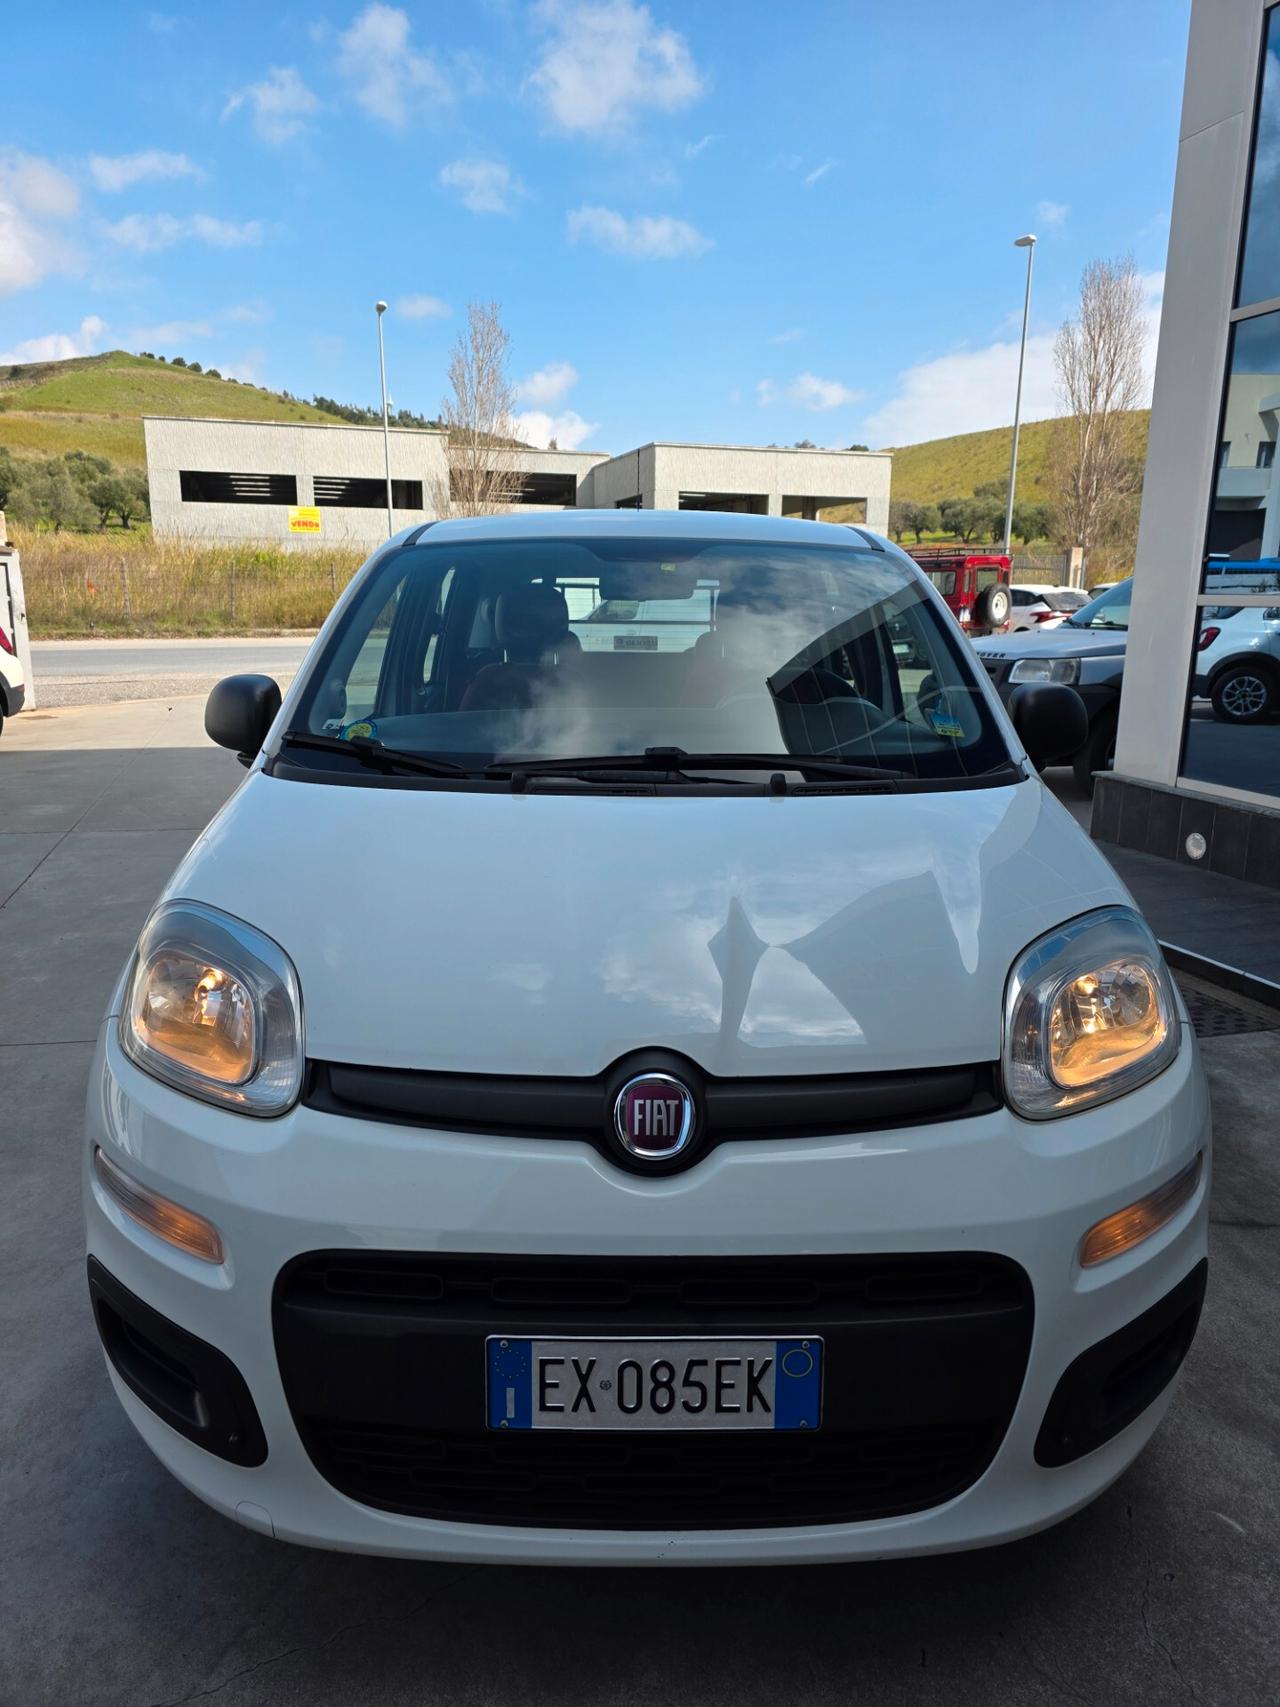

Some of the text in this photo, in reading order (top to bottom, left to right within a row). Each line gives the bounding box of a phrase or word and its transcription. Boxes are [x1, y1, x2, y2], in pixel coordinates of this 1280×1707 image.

[634, 1099, 679, 1136] FIAT
[538, 1356, 773, 1415] EX 085EK
